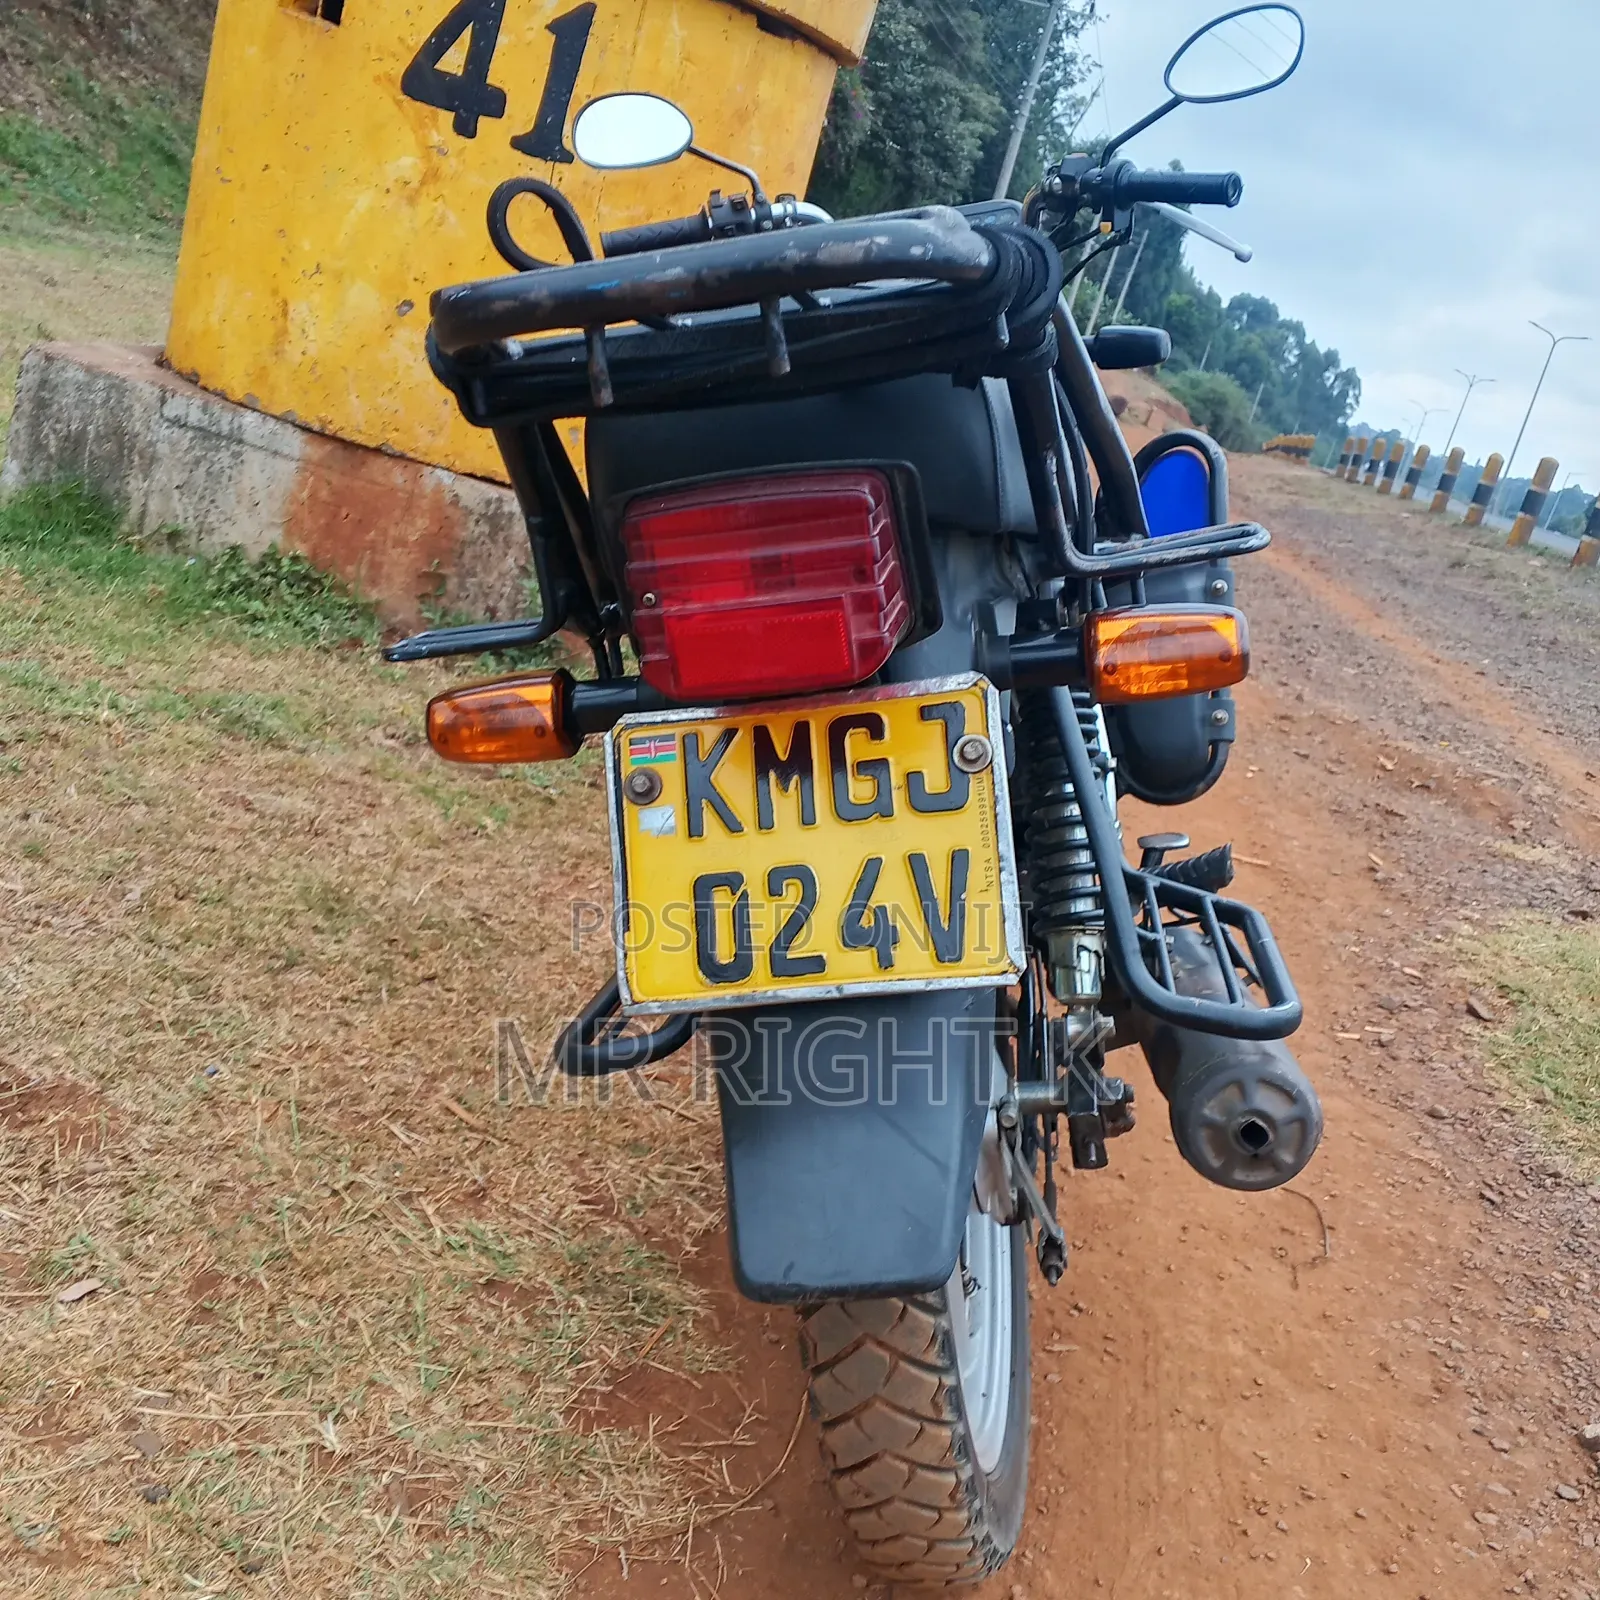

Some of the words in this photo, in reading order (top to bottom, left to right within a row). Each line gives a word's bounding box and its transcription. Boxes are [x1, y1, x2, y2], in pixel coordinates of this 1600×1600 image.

[401, 0, 595, 163] 41
[682, 701, 971, 838] KMGJ
[692, 848, 970, 985] 024V
[983, 857, 995, 888] NTSA
